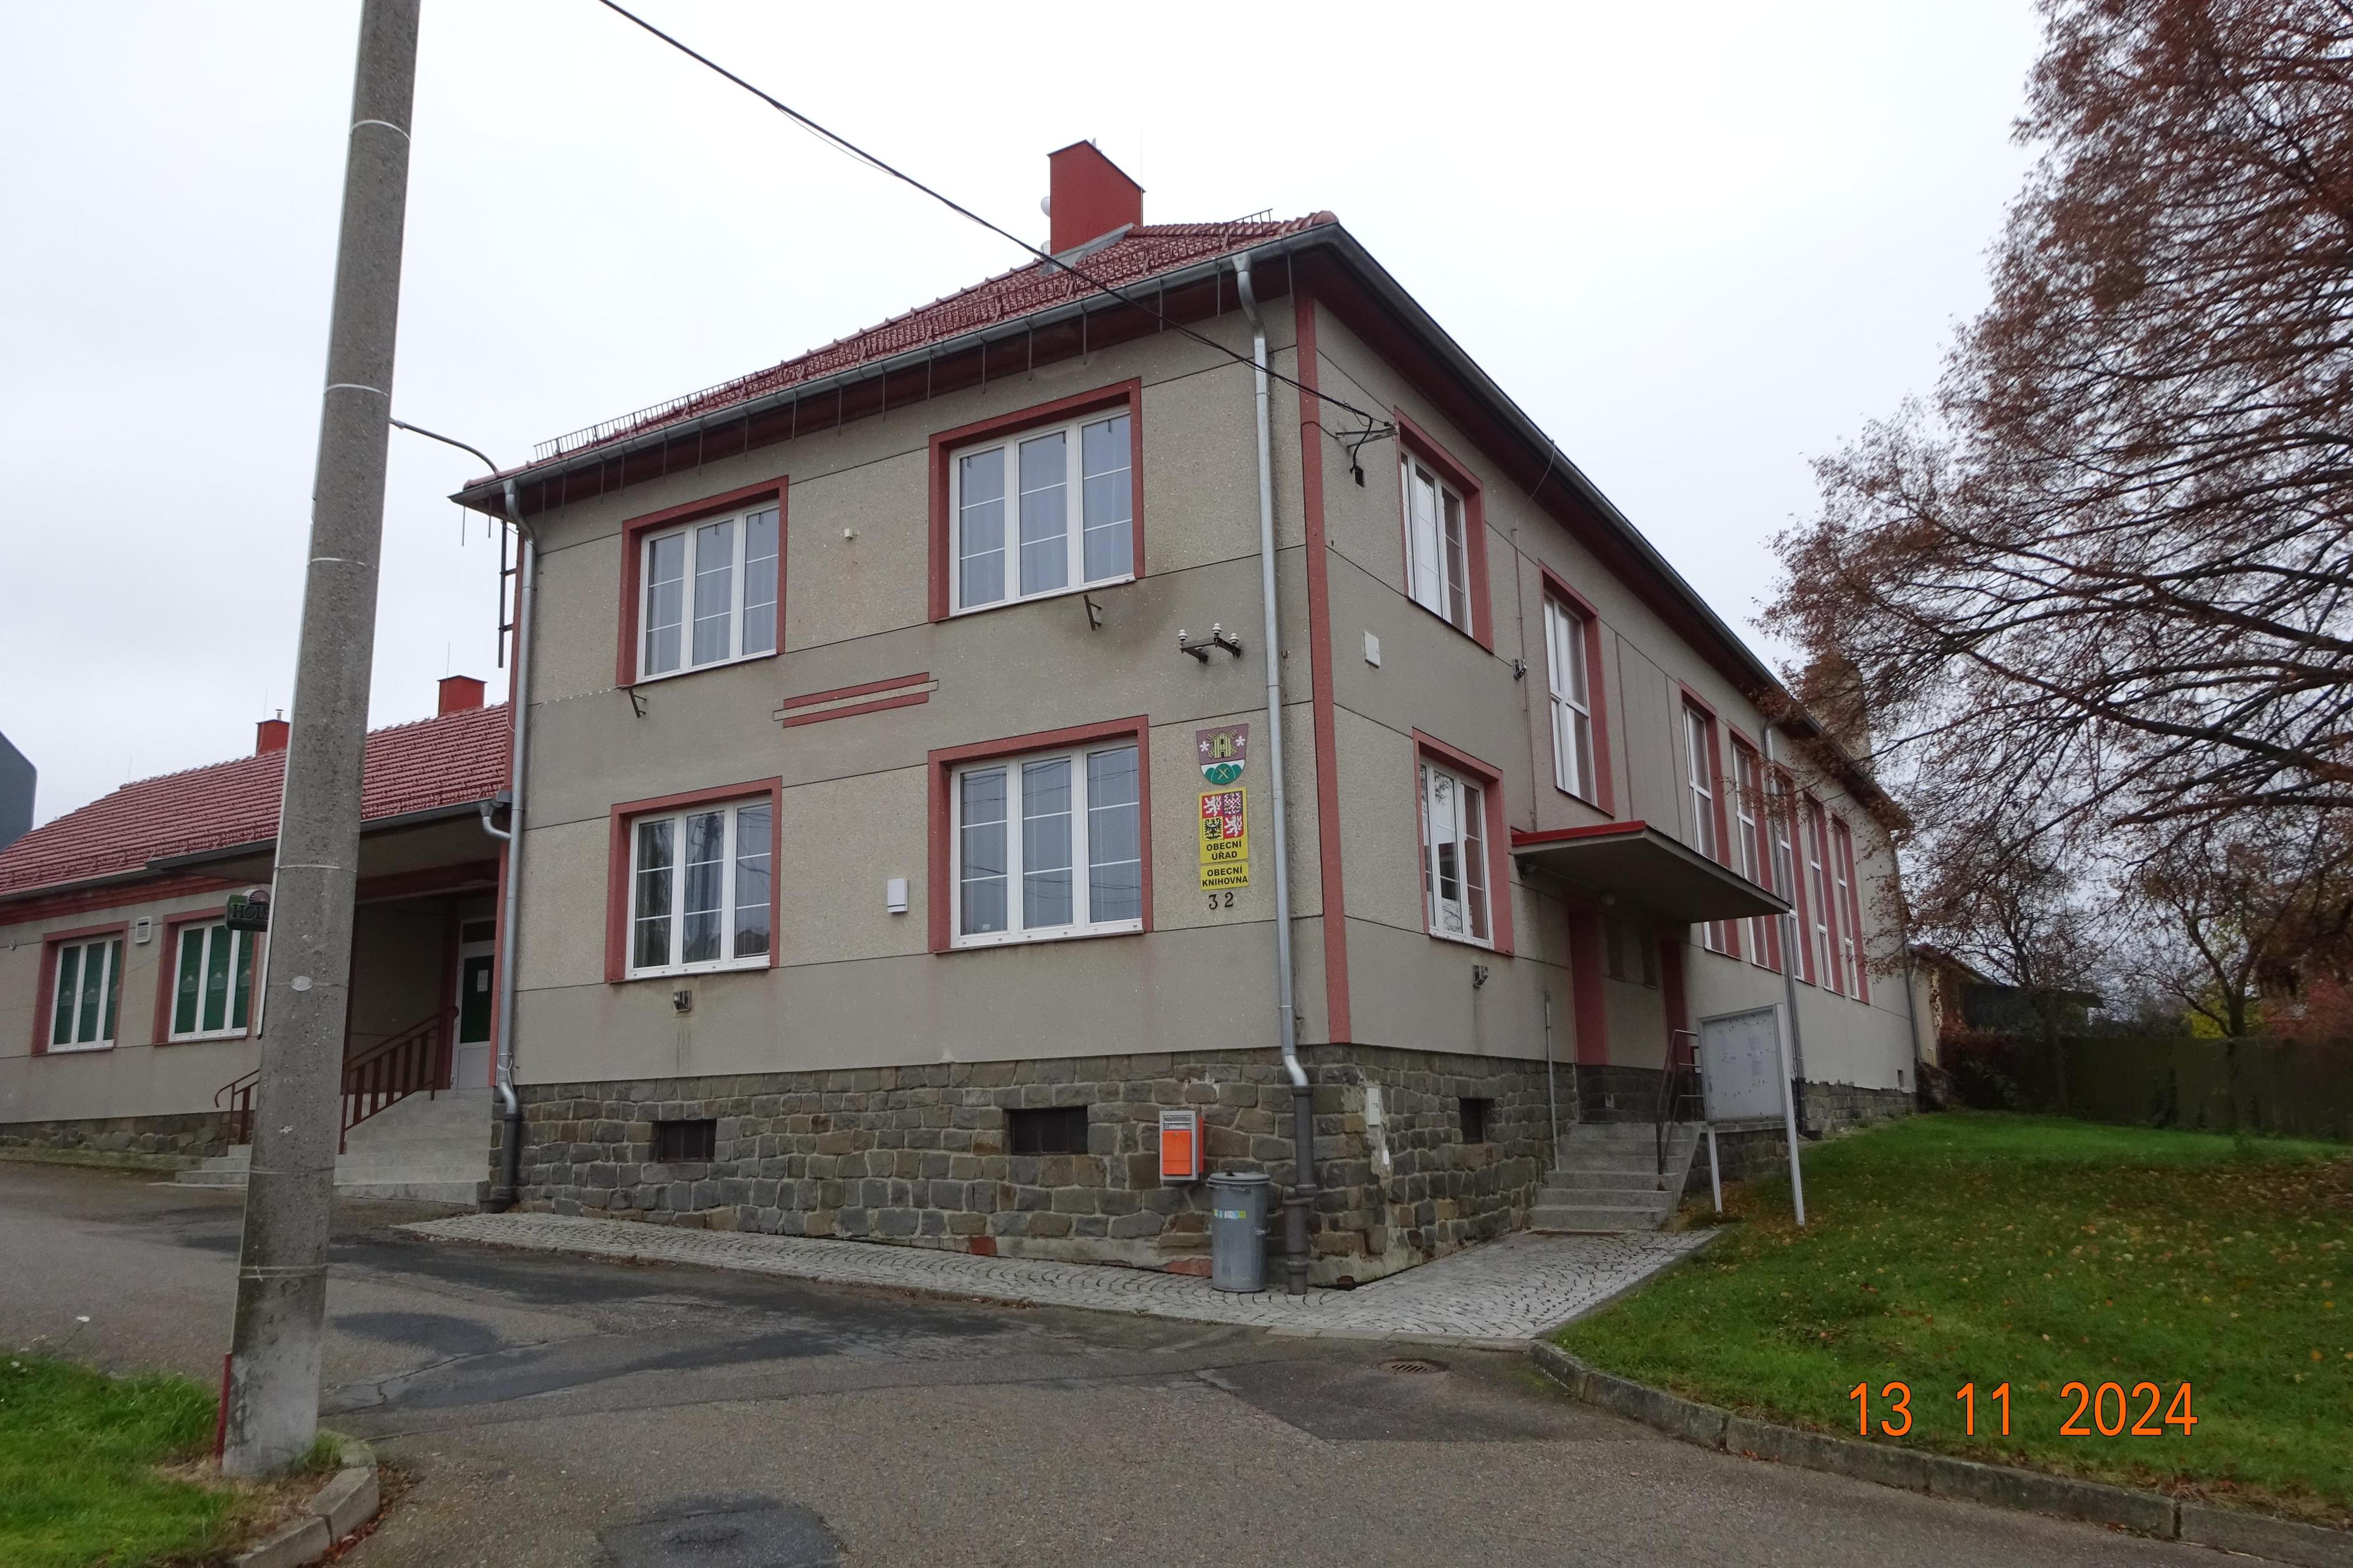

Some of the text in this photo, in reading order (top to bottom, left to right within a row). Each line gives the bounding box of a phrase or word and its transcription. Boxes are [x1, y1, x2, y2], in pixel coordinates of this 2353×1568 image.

[1206, 839, 1242, 852] OBECNÍ
[1212, 850, 1238, 860] ÚŘAD
[1207, 865, 1242, 877] OBECNÍ
[1202, 876, 1248, 887] KNIHOVNA
